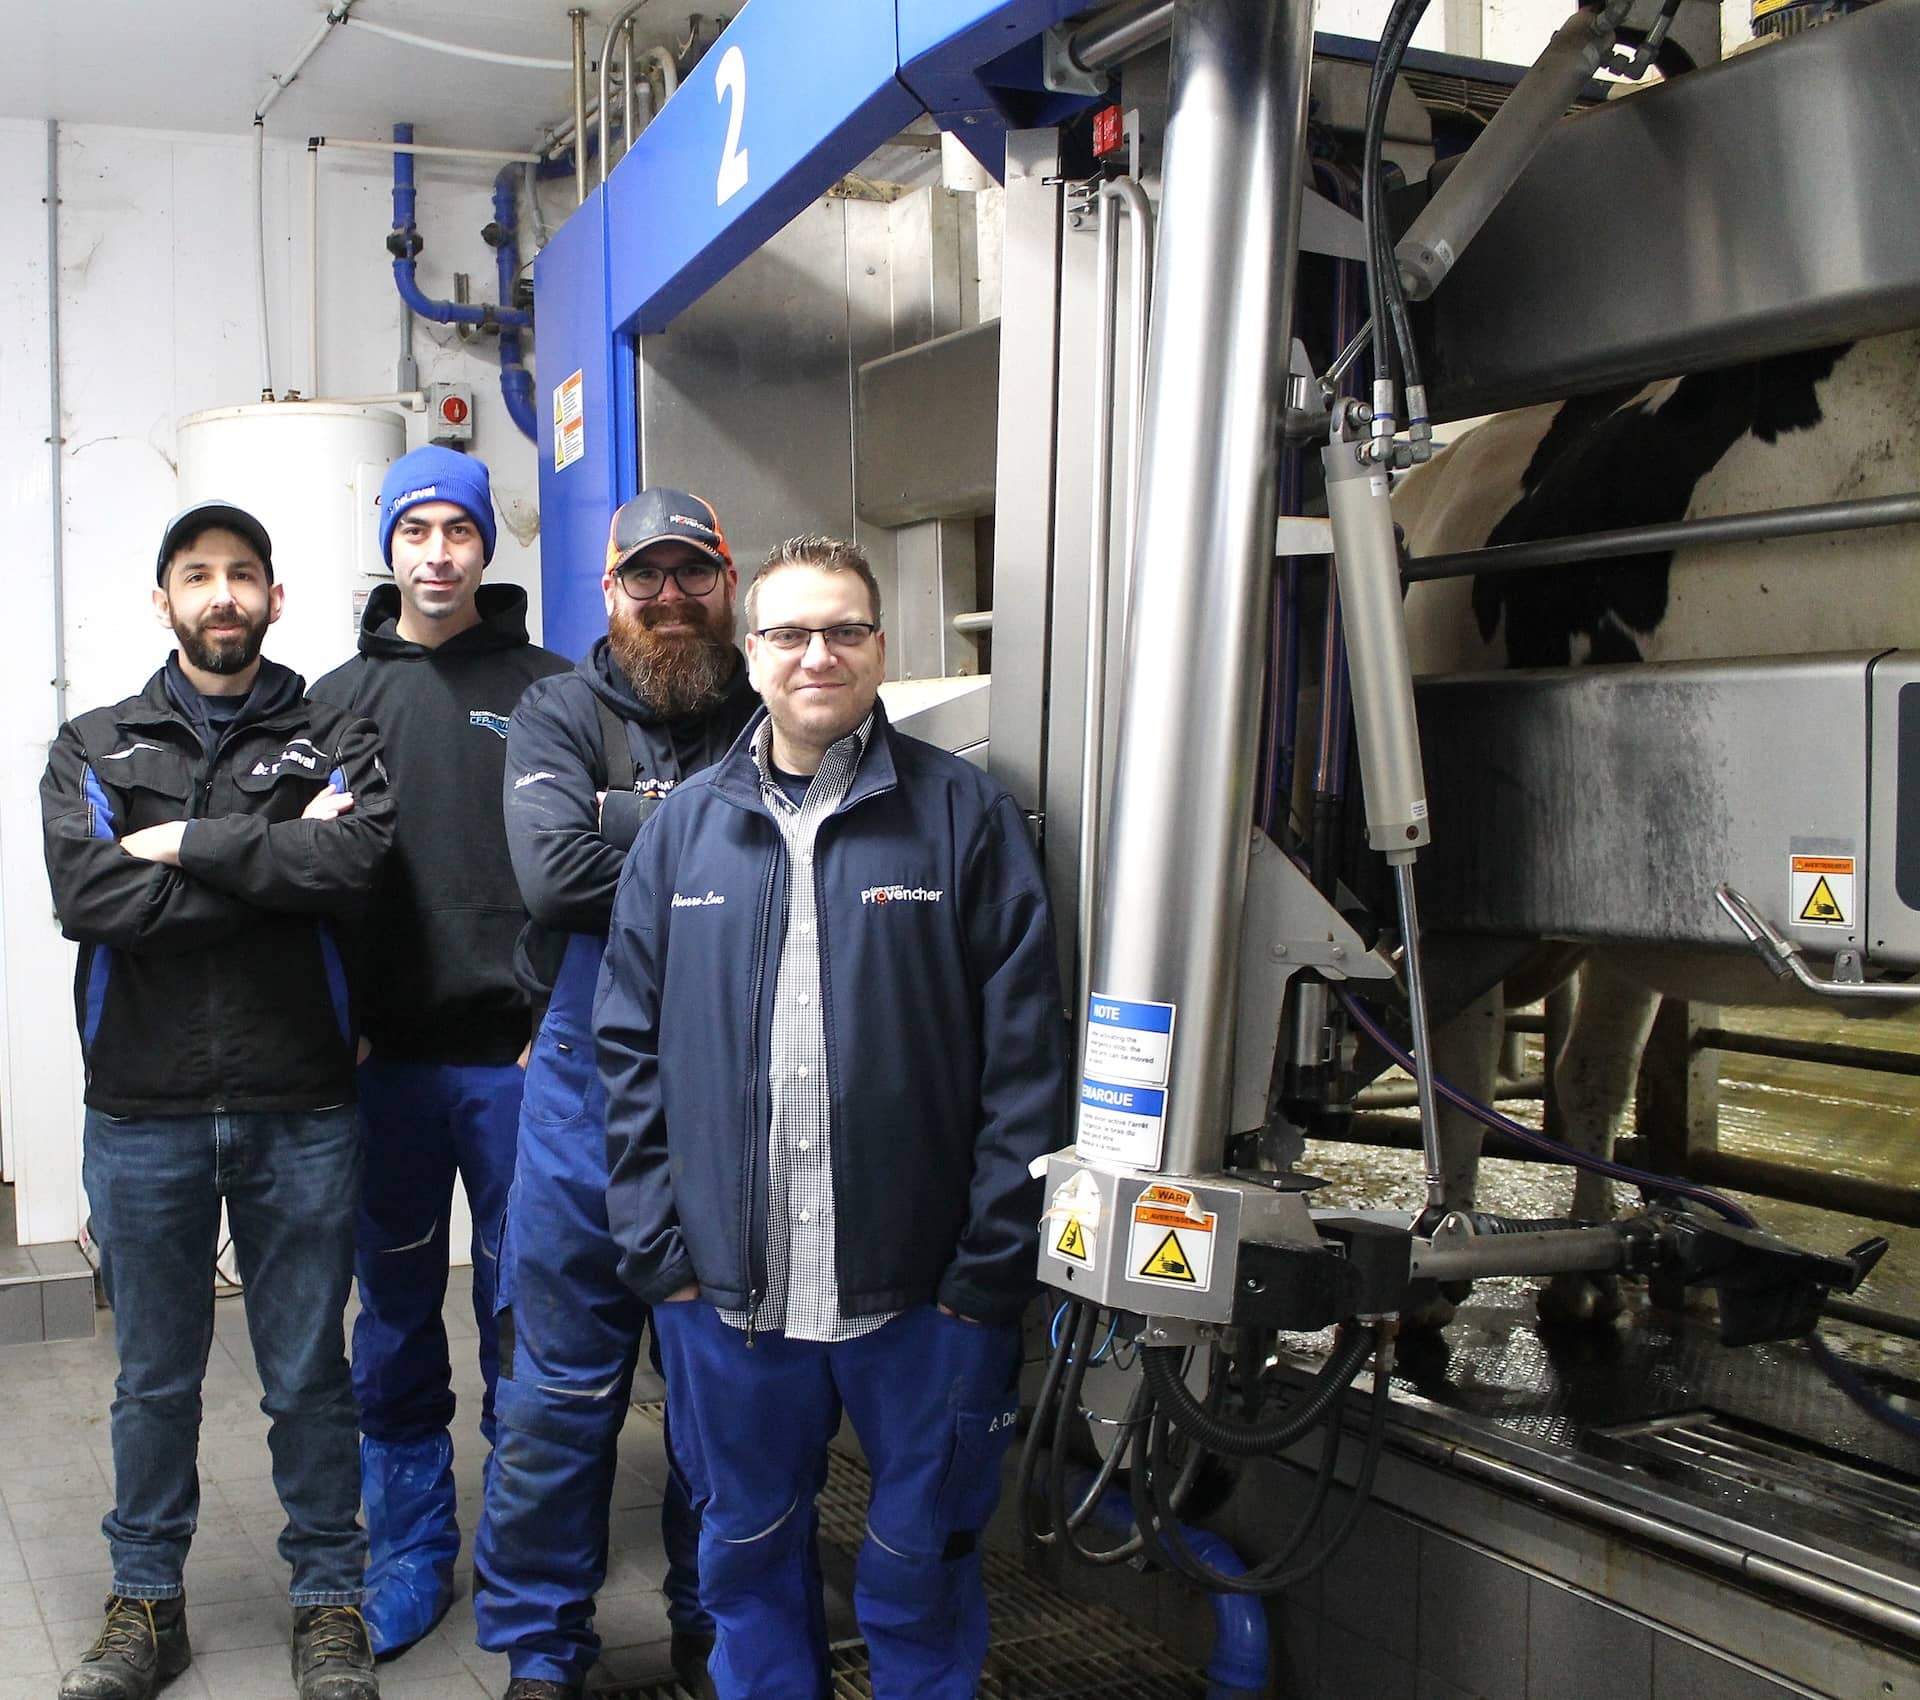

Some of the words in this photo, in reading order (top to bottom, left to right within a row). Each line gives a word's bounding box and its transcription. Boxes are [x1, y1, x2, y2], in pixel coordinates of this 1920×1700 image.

[715, 46, 748, 208] 2
[861, 887, 943, 904] Provencher
[1093, 1004, 1120, 1021] NOTE
[1130, 1056, 1154, 1064] moved
[1082, 1084, 1133, 1107] EMARQUE
[1158, 1189, 1190, 1204] WARN
